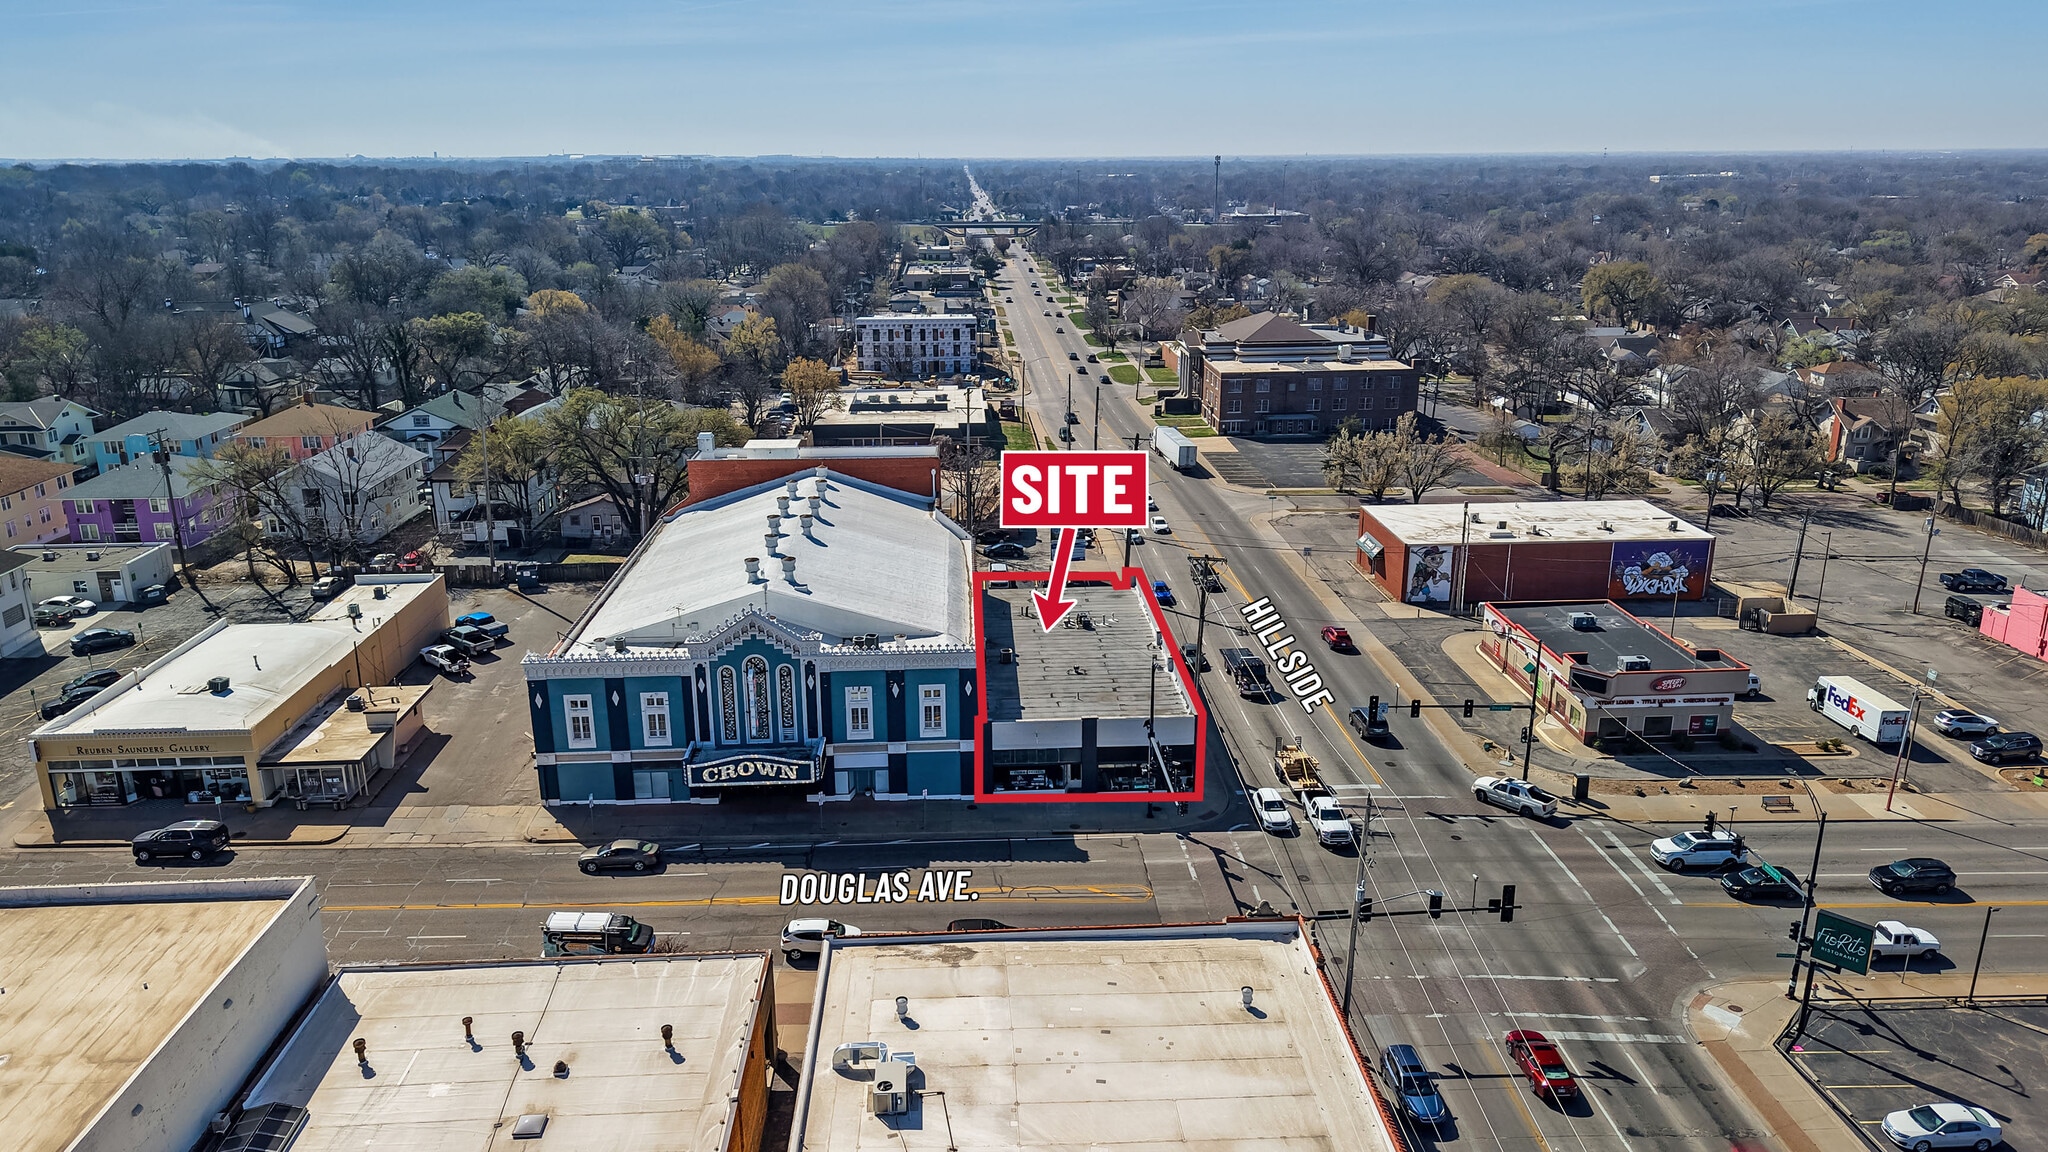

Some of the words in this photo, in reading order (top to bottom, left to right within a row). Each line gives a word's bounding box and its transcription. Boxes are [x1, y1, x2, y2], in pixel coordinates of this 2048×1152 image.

[1827, 685, 1866, 722] FedEx
[76, 746, 113, 755] REUBEN
[118, 745, 165, 754] SAUNDERS
[169, 743, 211, 753] GALLERY
[702, 761, 799, 783] CROWN
[1817, 927, 1867, 956] FioRito
[1821, 946, 1859, 963] RISTORANTE
